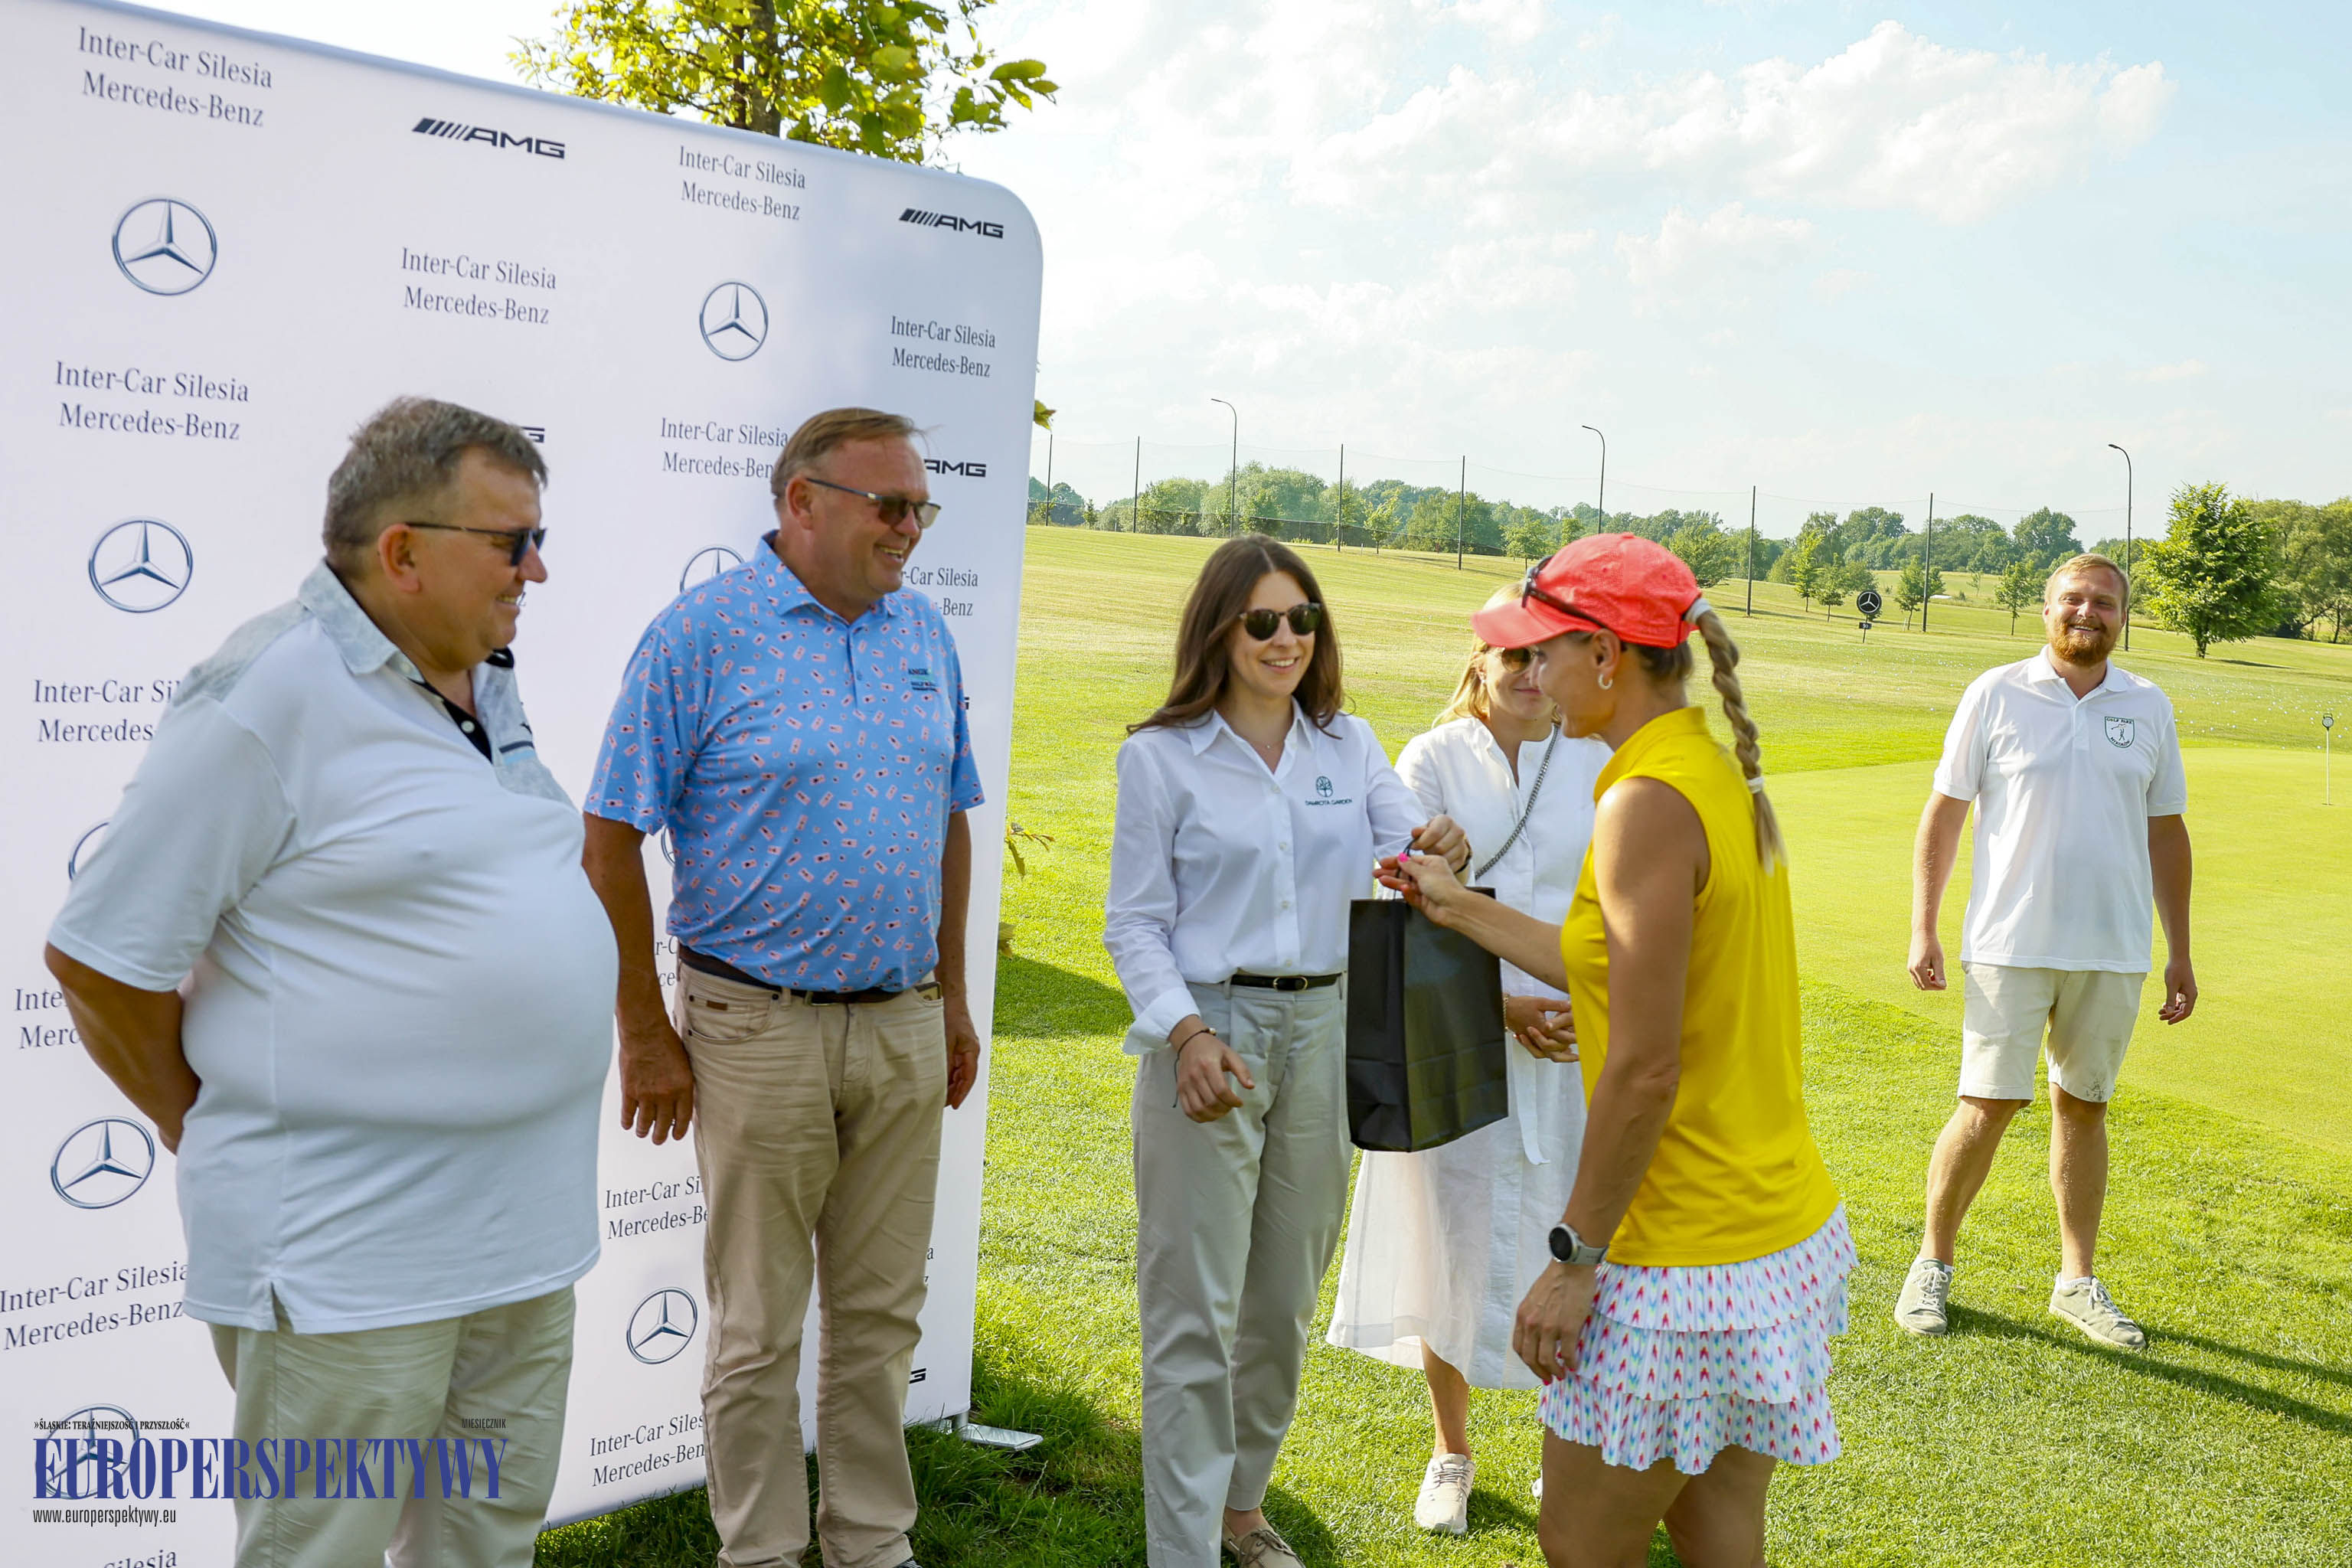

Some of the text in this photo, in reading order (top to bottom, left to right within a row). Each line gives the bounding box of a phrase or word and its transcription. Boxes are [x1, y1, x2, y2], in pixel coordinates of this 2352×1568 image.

[78, 25, 273, 89] Inter-Car Silesia
[82, 69, 264, 127] Mercedes-Benz
[678, 145, 806, 190] Inter-Car Silesia
[680, 180, 801, 221] Mercedes-Benz
[400, 247, 557, 290] Inter-Car Silesia
[403, 285, 550, 325] Mercedes-Benz
[890, 315, 996, 348] Inter-Car Silesia
[891, 346, 991, 378] Mercedes-Benz
[55, 361, 250, 403] Inter-Car Silesia
[58, 402, 240, 441] Mercedes-Benz
[660, 416, 788, 447] Inter-Car Silesia
[662, 451, 773, 479] Mercedes-Ben
[936, 567, 978, 587] Silesia
[34, 678, 144, 703] Inter-Car
[604, 1181, 681, 1209] Inter-Car
[607, 1205, 708, 1240] Mercedes-Be
[0, 1276, 109, 1313] Inter-Car
[3, 1301, 184, 1351] Mercedes-Benz
[589, 1413, 704, 1457] Inter-Car Siles
[592, 1443, 704, 1487] Mercedes-Ben
